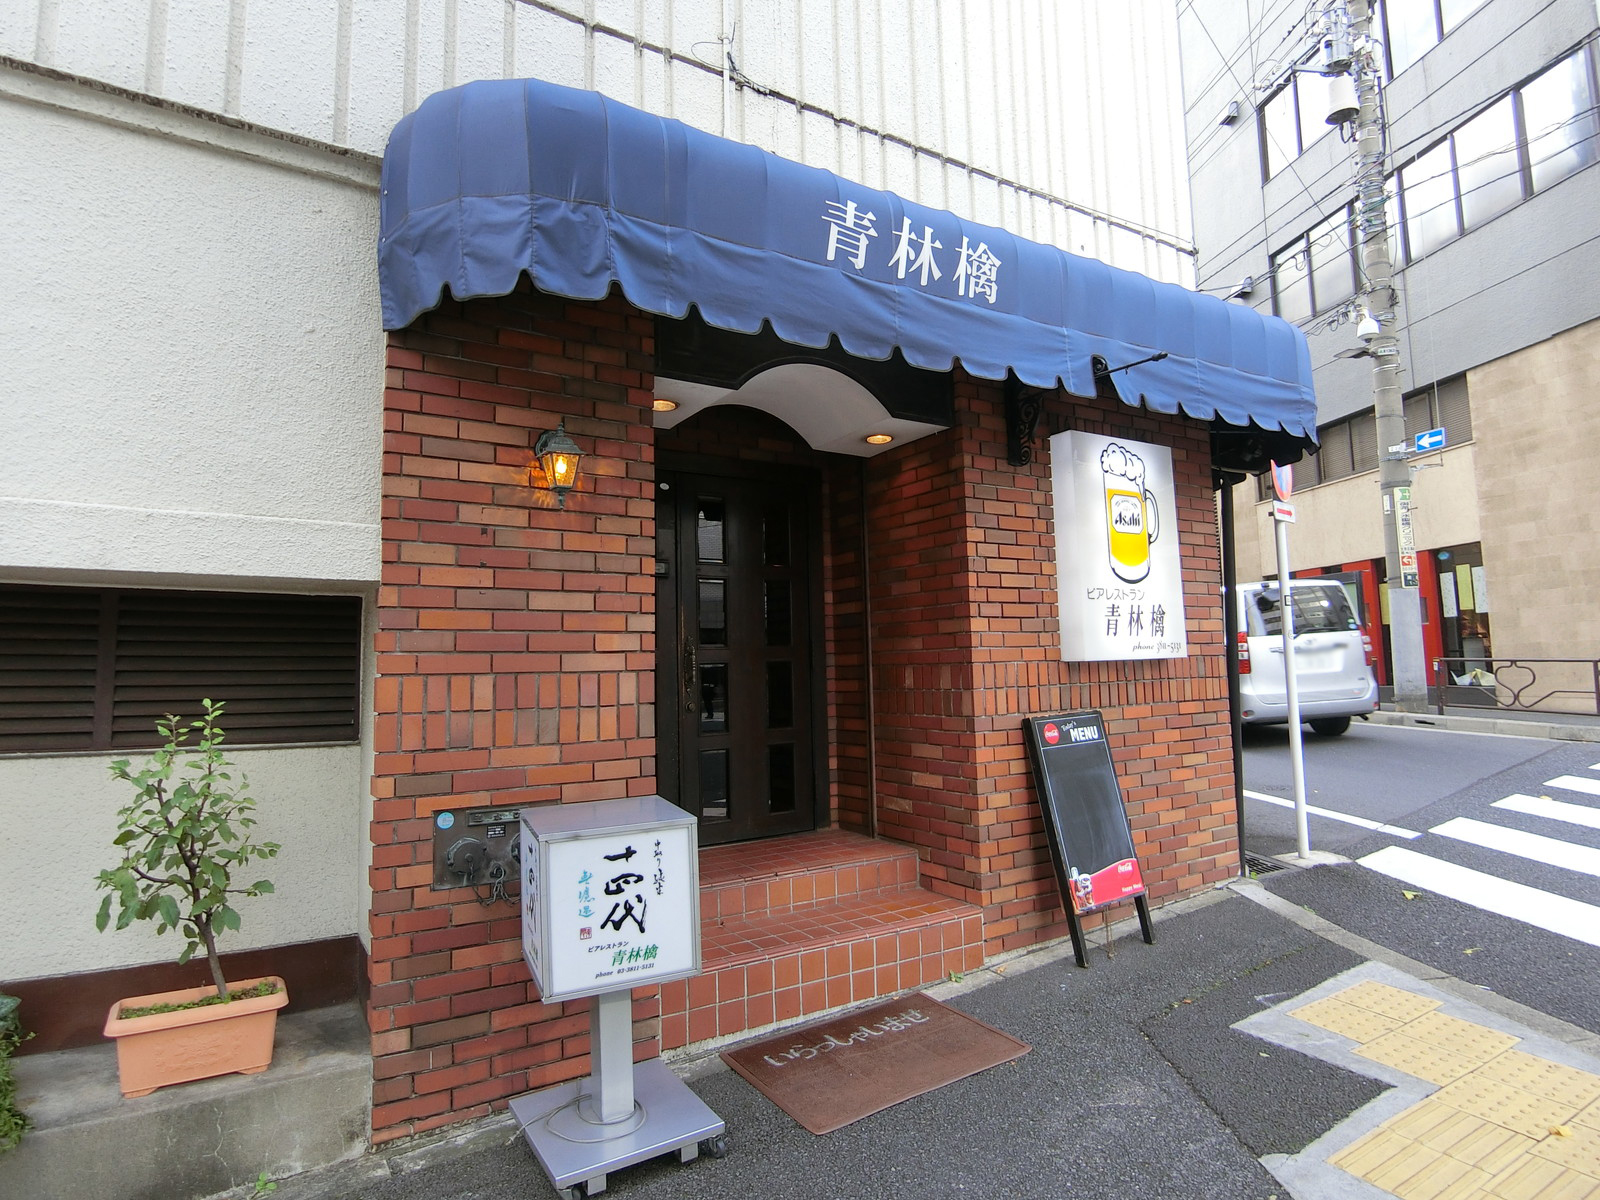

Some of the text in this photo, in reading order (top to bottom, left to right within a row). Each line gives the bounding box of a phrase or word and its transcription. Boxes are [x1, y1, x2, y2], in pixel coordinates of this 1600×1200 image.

[821, 200, 1002, 304] 青林檎
[1115, 511, 1141, 527] Asahi
[1104, 603, 1166, 637] 青林檎
[1132, 641, 1154, 652] phone
[1070, 725, 1099, 742] MENU
[600, 845, 647, 933] 十四代
[612, 944, 659, 967] 青林檎
[595, 970, 613, 979] phone
[763, 1008, 930, 1067] いらっしゃいませ
